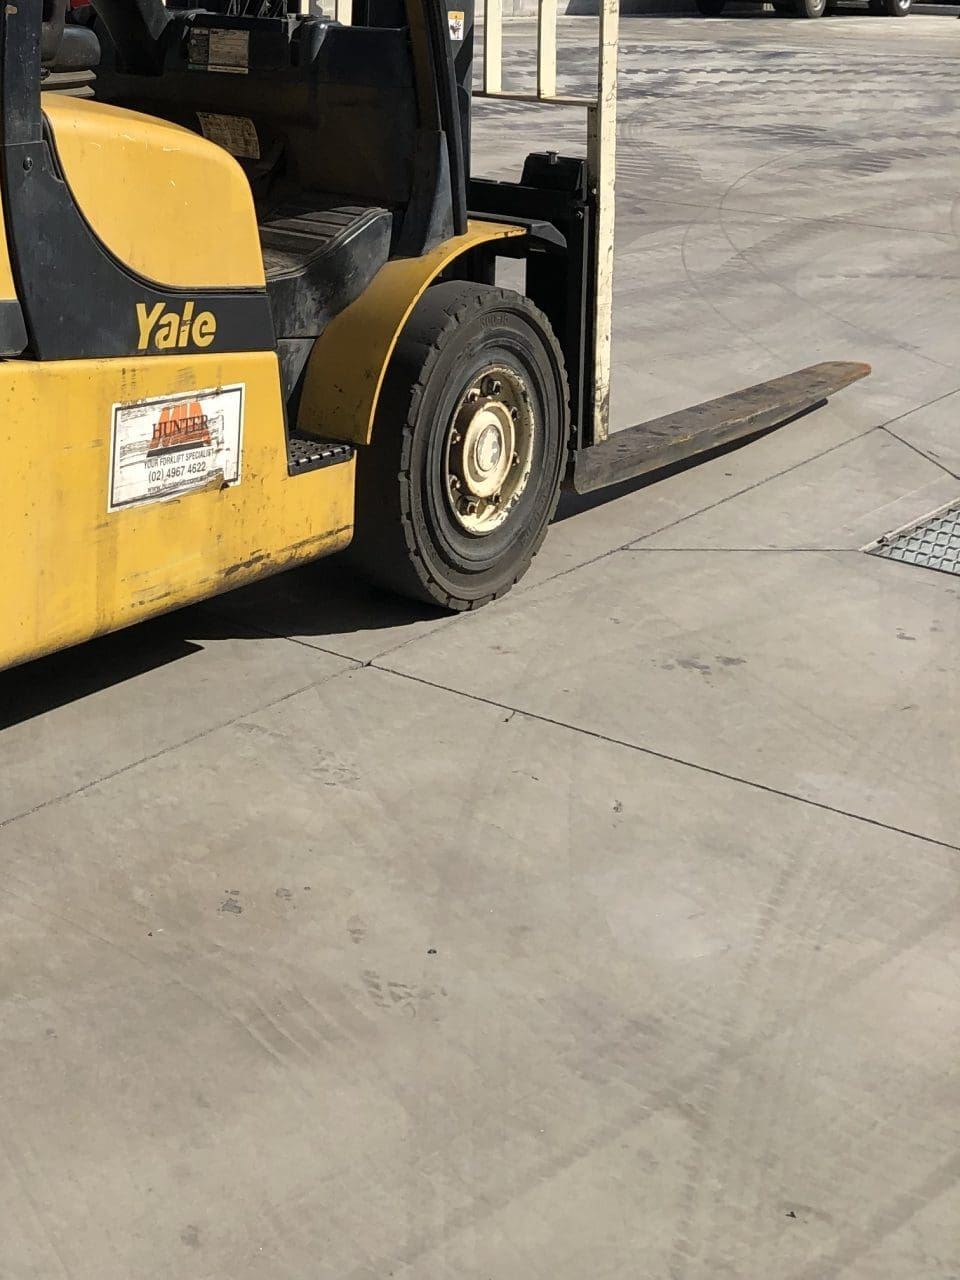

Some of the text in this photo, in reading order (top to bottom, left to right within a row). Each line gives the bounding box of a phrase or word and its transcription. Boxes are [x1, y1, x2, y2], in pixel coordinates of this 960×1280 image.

[136, 301, 217, 350] Yale
[152, 414, 209, 441] HUNTER
[160, 453, 185, 466] FORKLIFT
[148, 469, 164, 483] (02)
[166, 466, 185, 478] 4967
[187, 461, 206, 474] 4622
